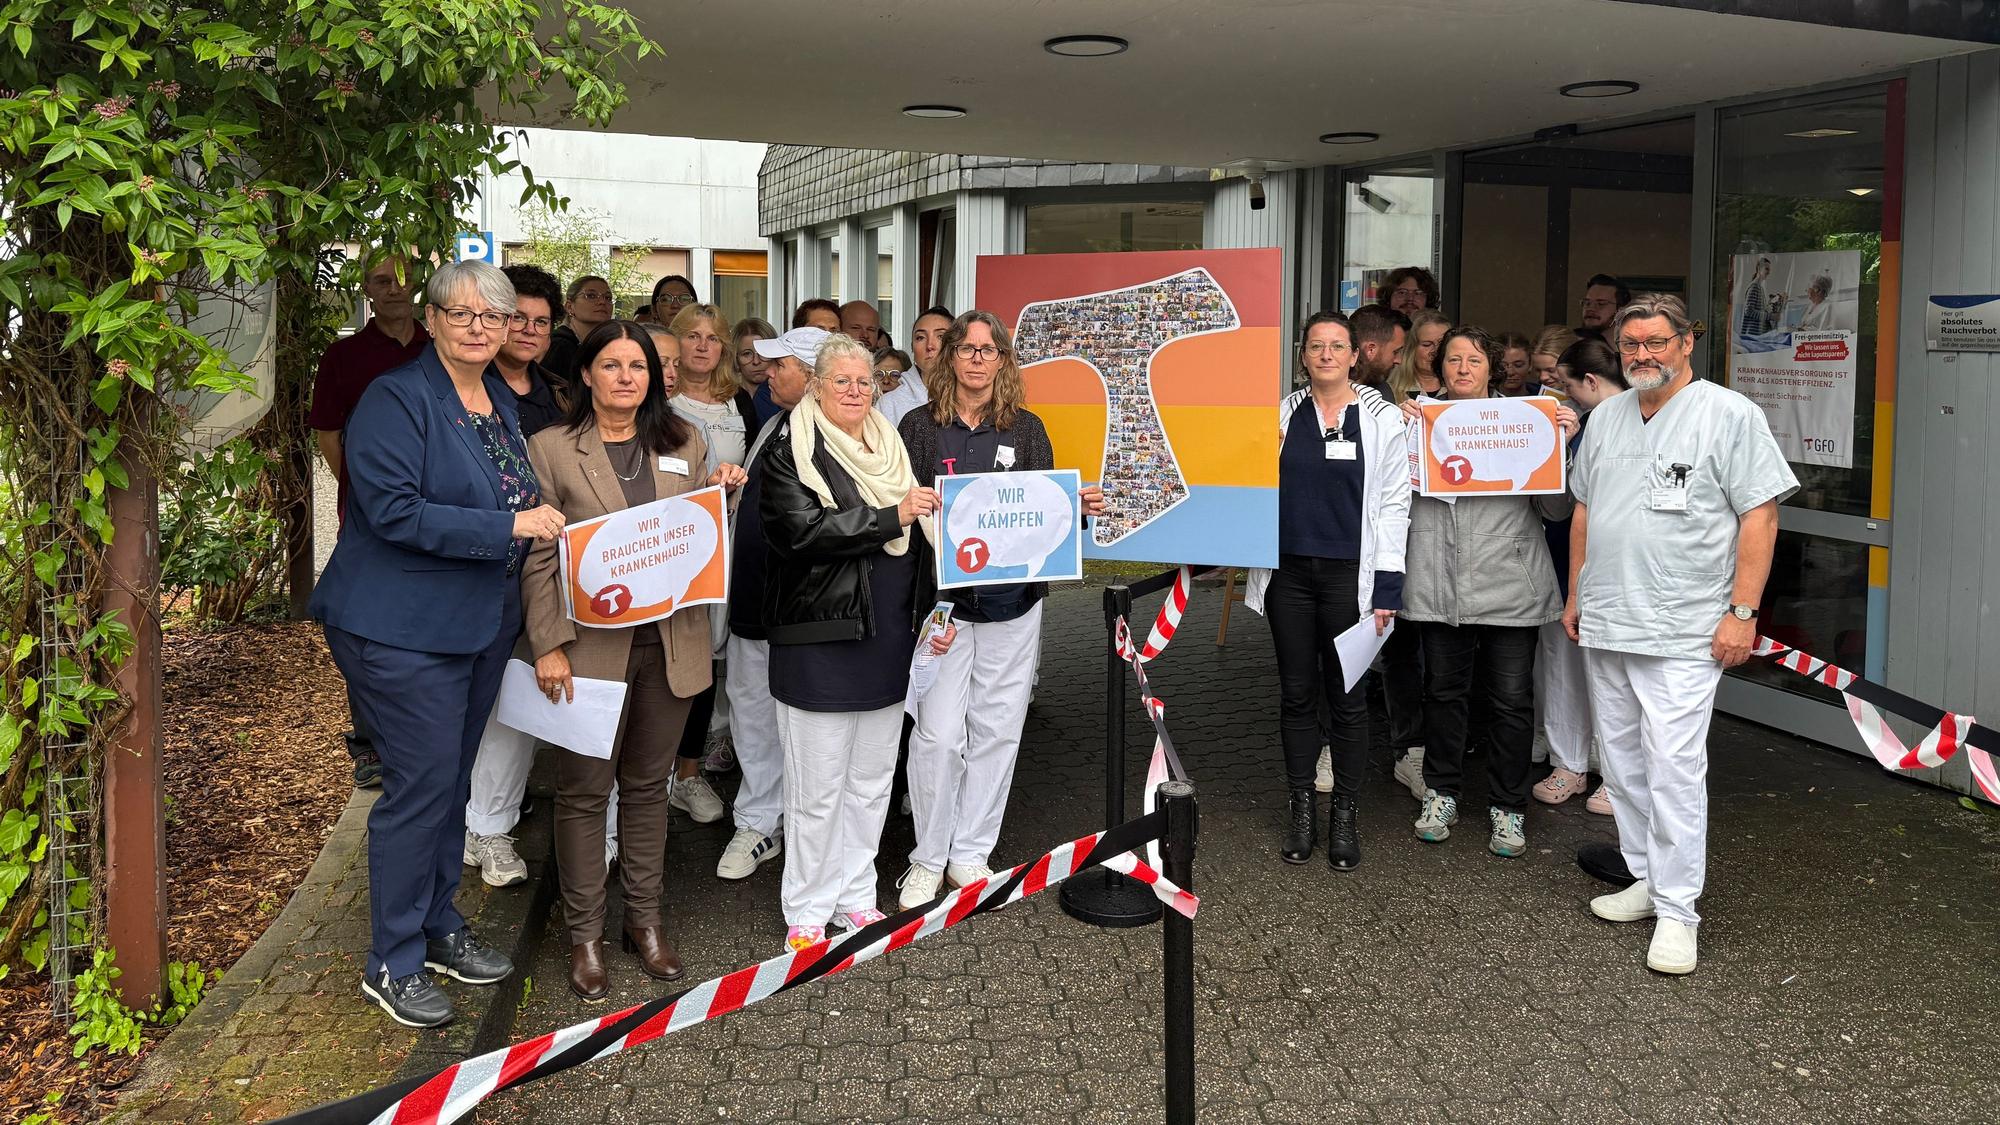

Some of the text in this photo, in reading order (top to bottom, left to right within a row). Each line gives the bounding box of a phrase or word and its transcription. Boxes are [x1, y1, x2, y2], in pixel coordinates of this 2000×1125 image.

[460, 238, 488, 262] P
[1940, 318, 1983, 326] absolutes
[1940, 326, 1998, 335] Rauchverbot
[1737, 367, 1849, 379] KRANKENHAUSVERSORGUNG IST
[1757, 377, 1770, 385] ALS
[1770, 378, 1836, 388] KOSTENEFFIZIENZ.
[1776, 392, 1813, 401] Sicherheit
[1479, 410, 1500, 421] WIR
[1448, 423, 1534, 437] BRAUCHEN UNSER
[1454, 437, 1530, 451] KRANKENHAUS!
[1814, 438, 1835, 453] GFO
[997, 487, 1025, 504] WIR
[637, 516, 660, 534] WIR
[978, 510, 1044, 529] KÄMPFEN
[602, 523, 696, 563] BRAUCHEN UNSER
[610, 542, 690, 579] KRANKENHAUS!
